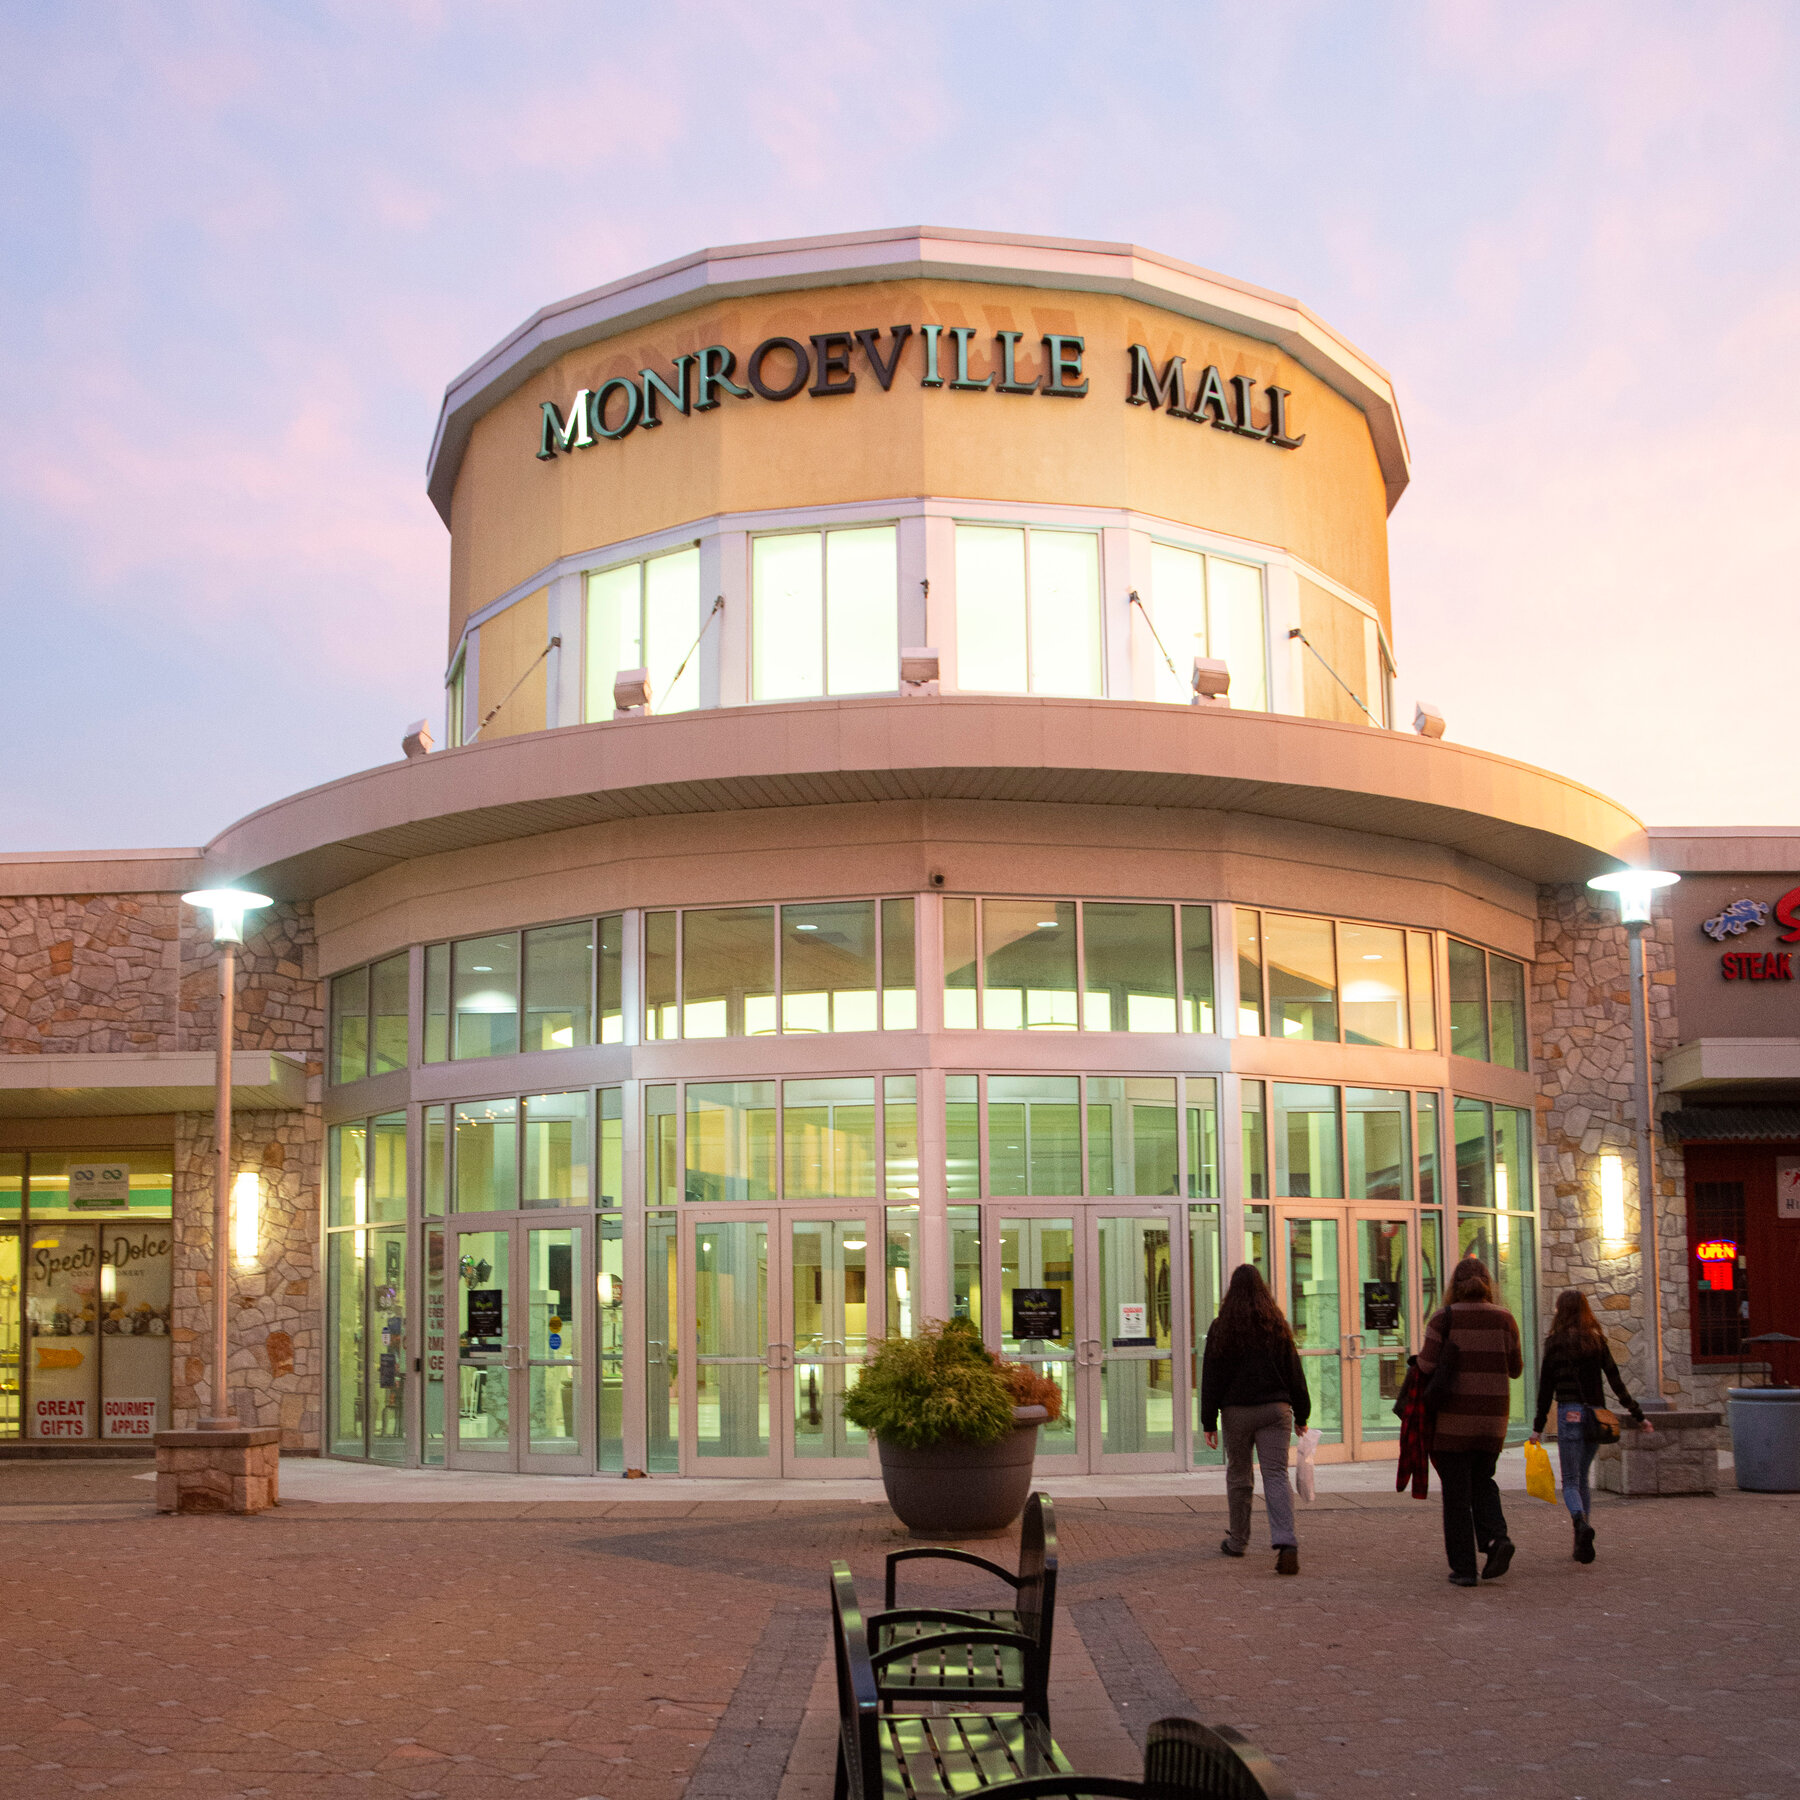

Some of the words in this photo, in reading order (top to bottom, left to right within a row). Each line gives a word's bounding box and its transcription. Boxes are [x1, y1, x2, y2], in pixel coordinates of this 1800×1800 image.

[536, 324, 1090, 461] MONROEVILLE
[1126, 343, 1306, 451] MALL
[1722, 952, 1794, 980] STEAK
[113, 1234, 171, 1268] Dolce
[1698, 1243, 1735, 1259] OPEN
[37, 1400, 85, 1416] GREAT
[104, 1401, 155, 1416] GOURMET
[40, 1420, 83, 1435] GIFTS
[111, 1420, 150, 1434] APPLES
